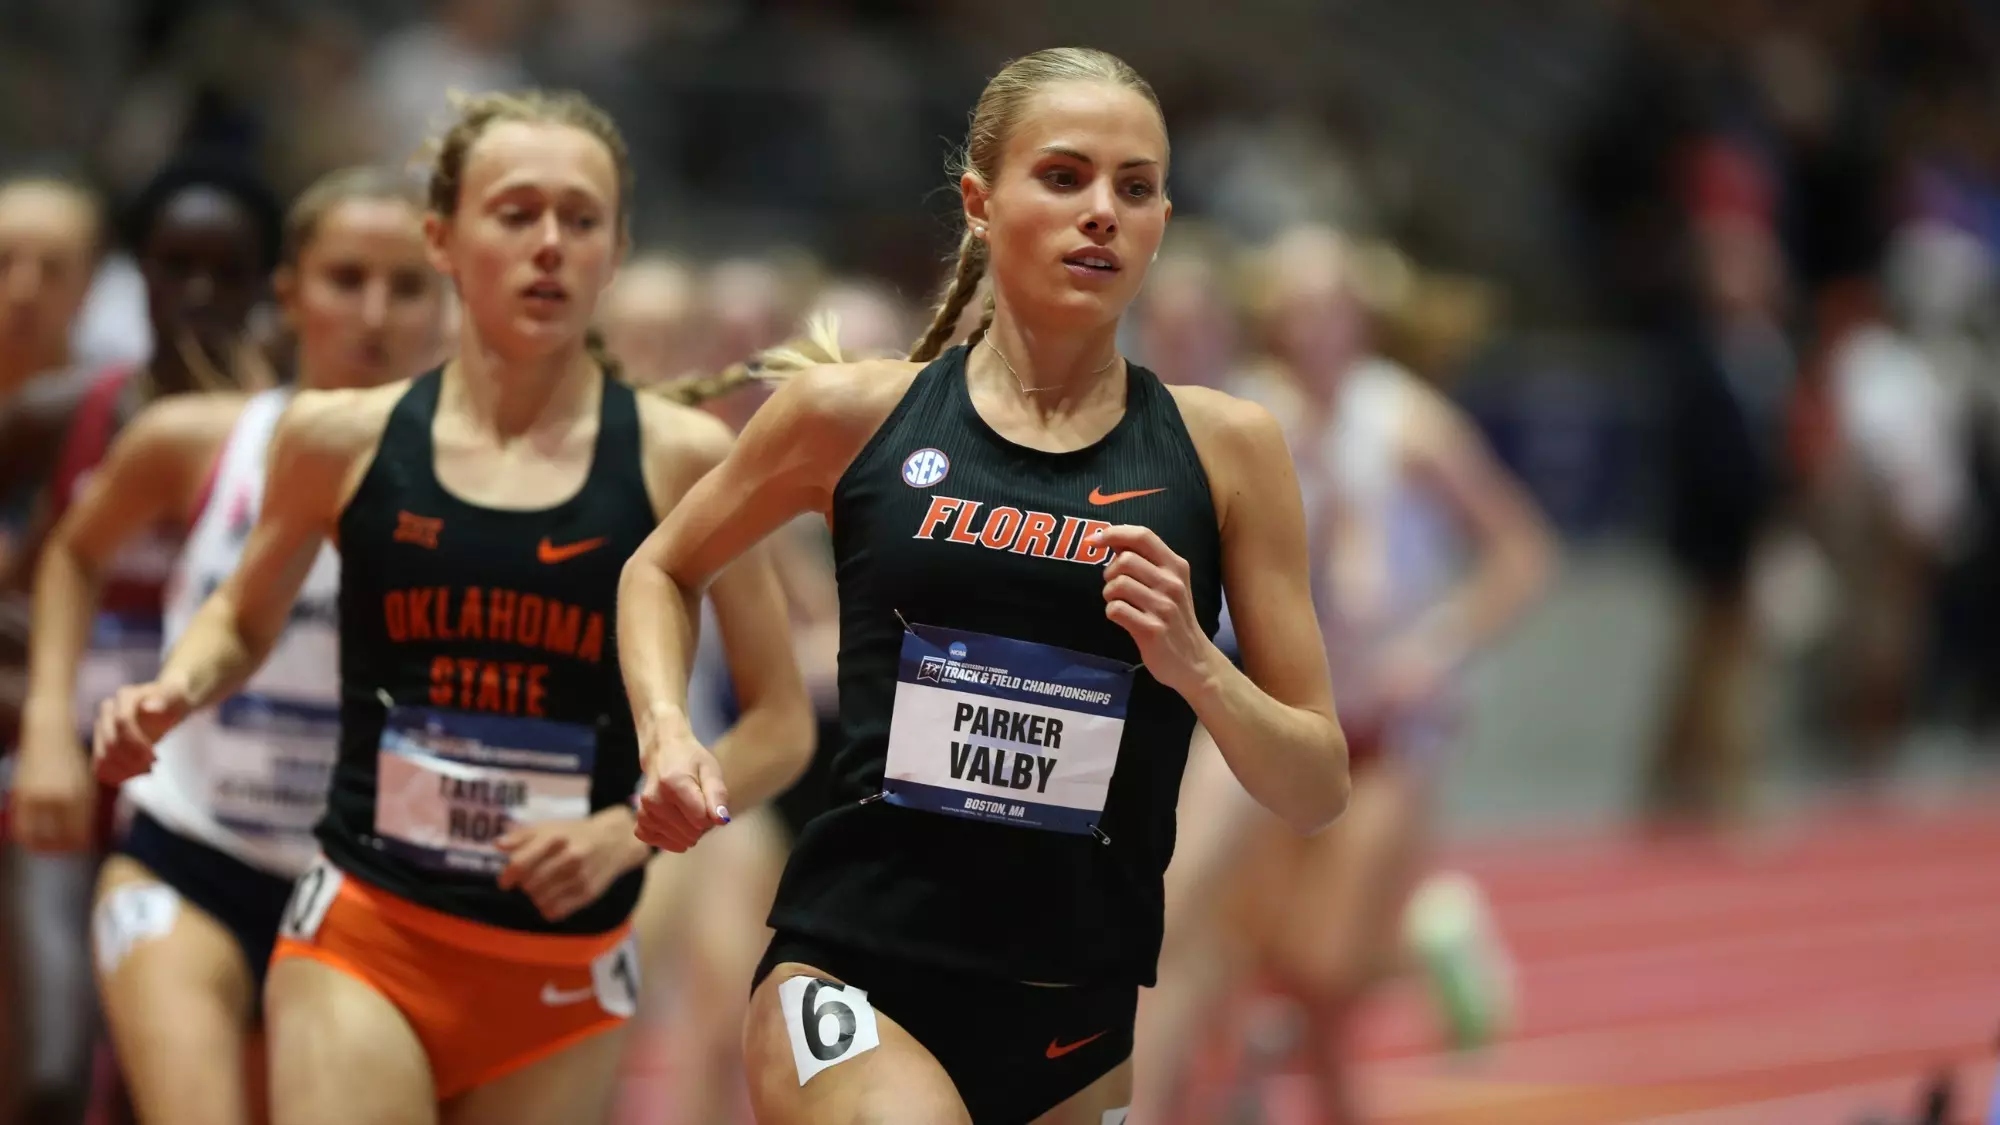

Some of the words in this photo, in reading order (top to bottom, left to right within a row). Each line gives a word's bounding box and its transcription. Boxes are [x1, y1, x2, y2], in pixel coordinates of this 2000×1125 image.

[906, 450, 947, 485] SEC
[912, 495, 1117, 567] FLORID
[384, 585, 605, 664] OKLAHOMA
[429, 655, 549, 717] STATE
[944, 665, 981, 683] TRACK
[980, 671, 990, 684] &
[989, 673, 1021, 690] FIELD
[1022, 679, 1112, 705] CHAMPIONSHIPS
[953, 702, 1064, 749] PARKER
[950, 741, 1058, 794] VALBY
[964, 798, 1007, 816] BOSTON,
[1008, 806, 1025, 818] MA
[802, 978, 857, 1061] 6
